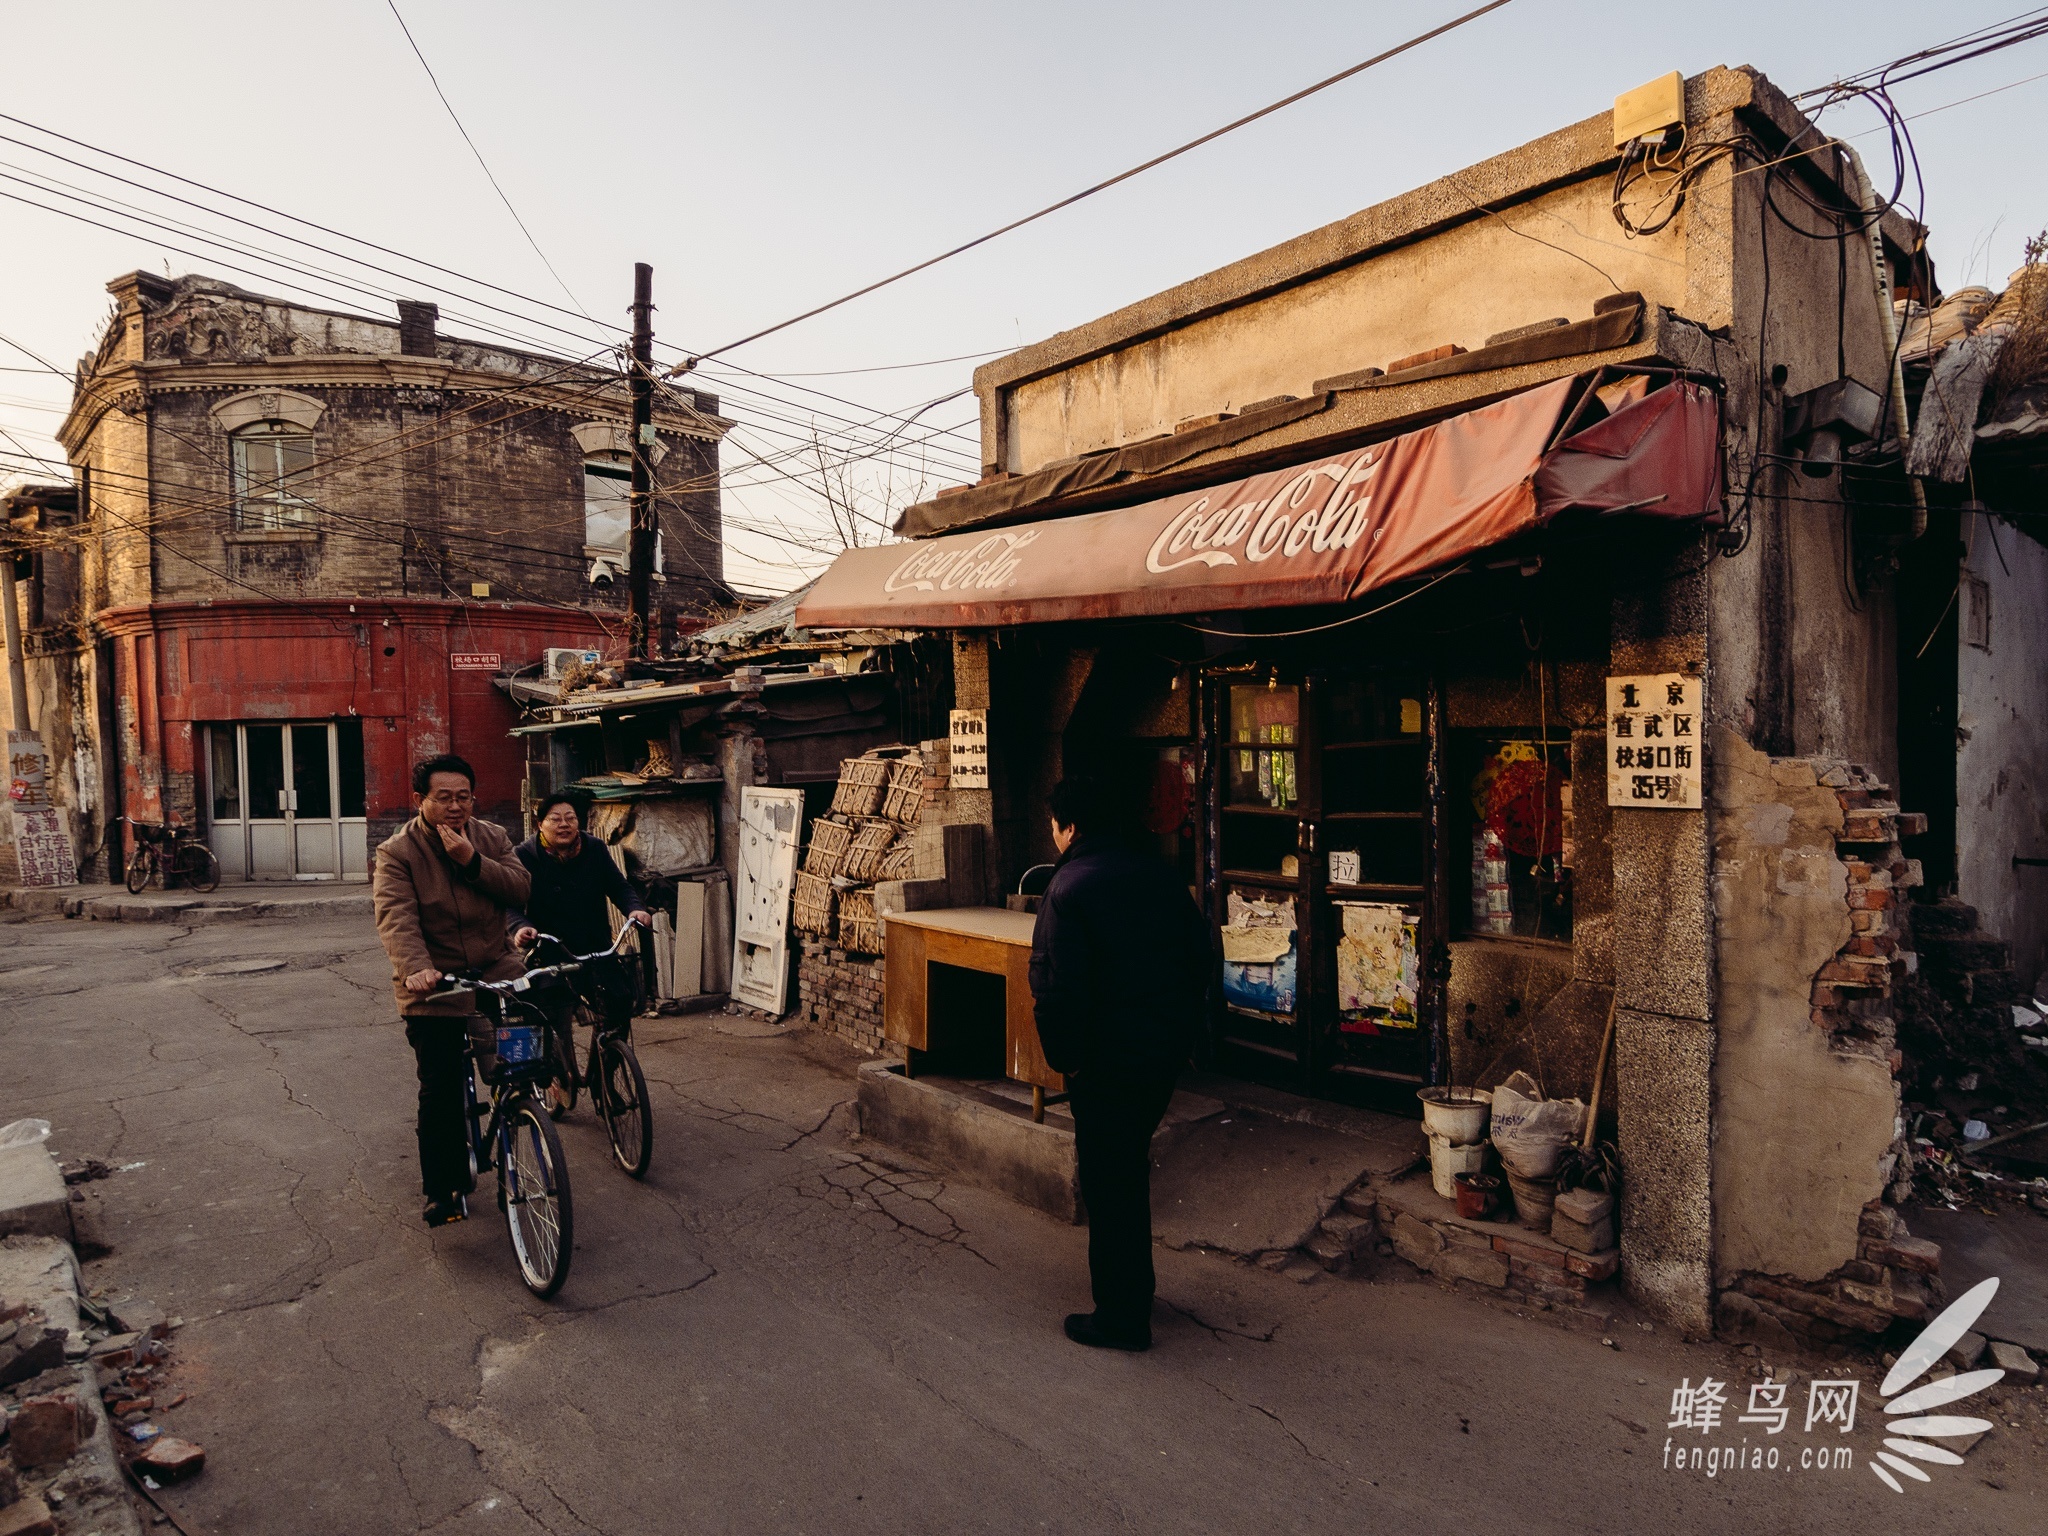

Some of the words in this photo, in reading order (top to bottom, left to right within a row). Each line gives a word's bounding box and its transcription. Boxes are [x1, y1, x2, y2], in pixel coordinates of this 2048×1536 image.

[1146, 452, 1383, 574] Coca-Cola
[884, 528, 1044, 593] Coca-Cola
[1619, 681, 1685, 708] 北京
[952, 720, 984, 734] 营业时间
[1615, 713, 1693, 738] 宣武区
[1615, 745, 1693, 769] 校场口街
[1631, 774, 1672, 800] 35号
[1332, 855, 1355, 881] 拉
